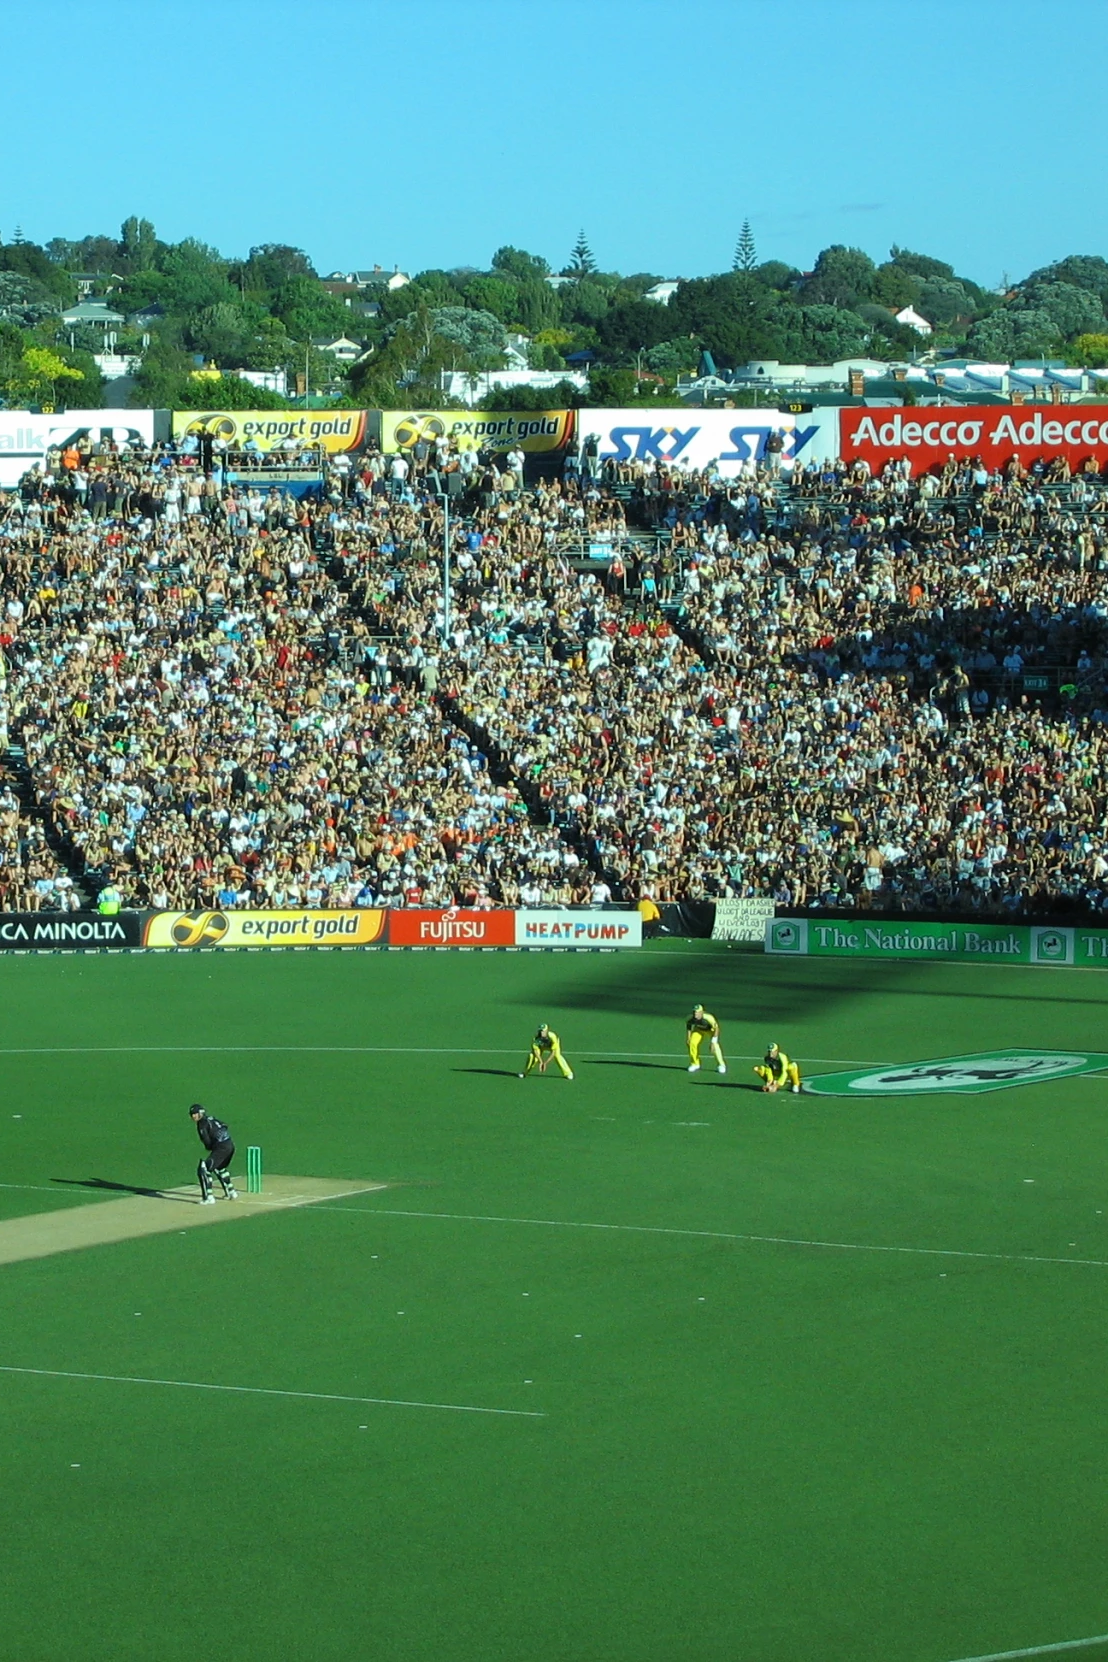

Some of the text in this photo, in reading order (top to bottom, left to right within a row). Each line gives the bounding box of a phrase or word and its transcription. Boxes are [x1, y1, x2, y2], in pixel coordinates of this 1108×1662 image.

[789, 404, 802, 412] 123
[243, 416, 353, 440] export gold
[452, 416, 559, 440] export gold
[850, 414, 984, 446] Adecco
[599, 427, 702, 461] SKY
[33, 921, 126, 940] MINOLTA
[242, 915, 359, 939] export gold
[420, 920, 485, 943] FUJITSU
[525, 922, 629, 940] HEATPUMP
[815, 926, 1021, 955] The National Bank
